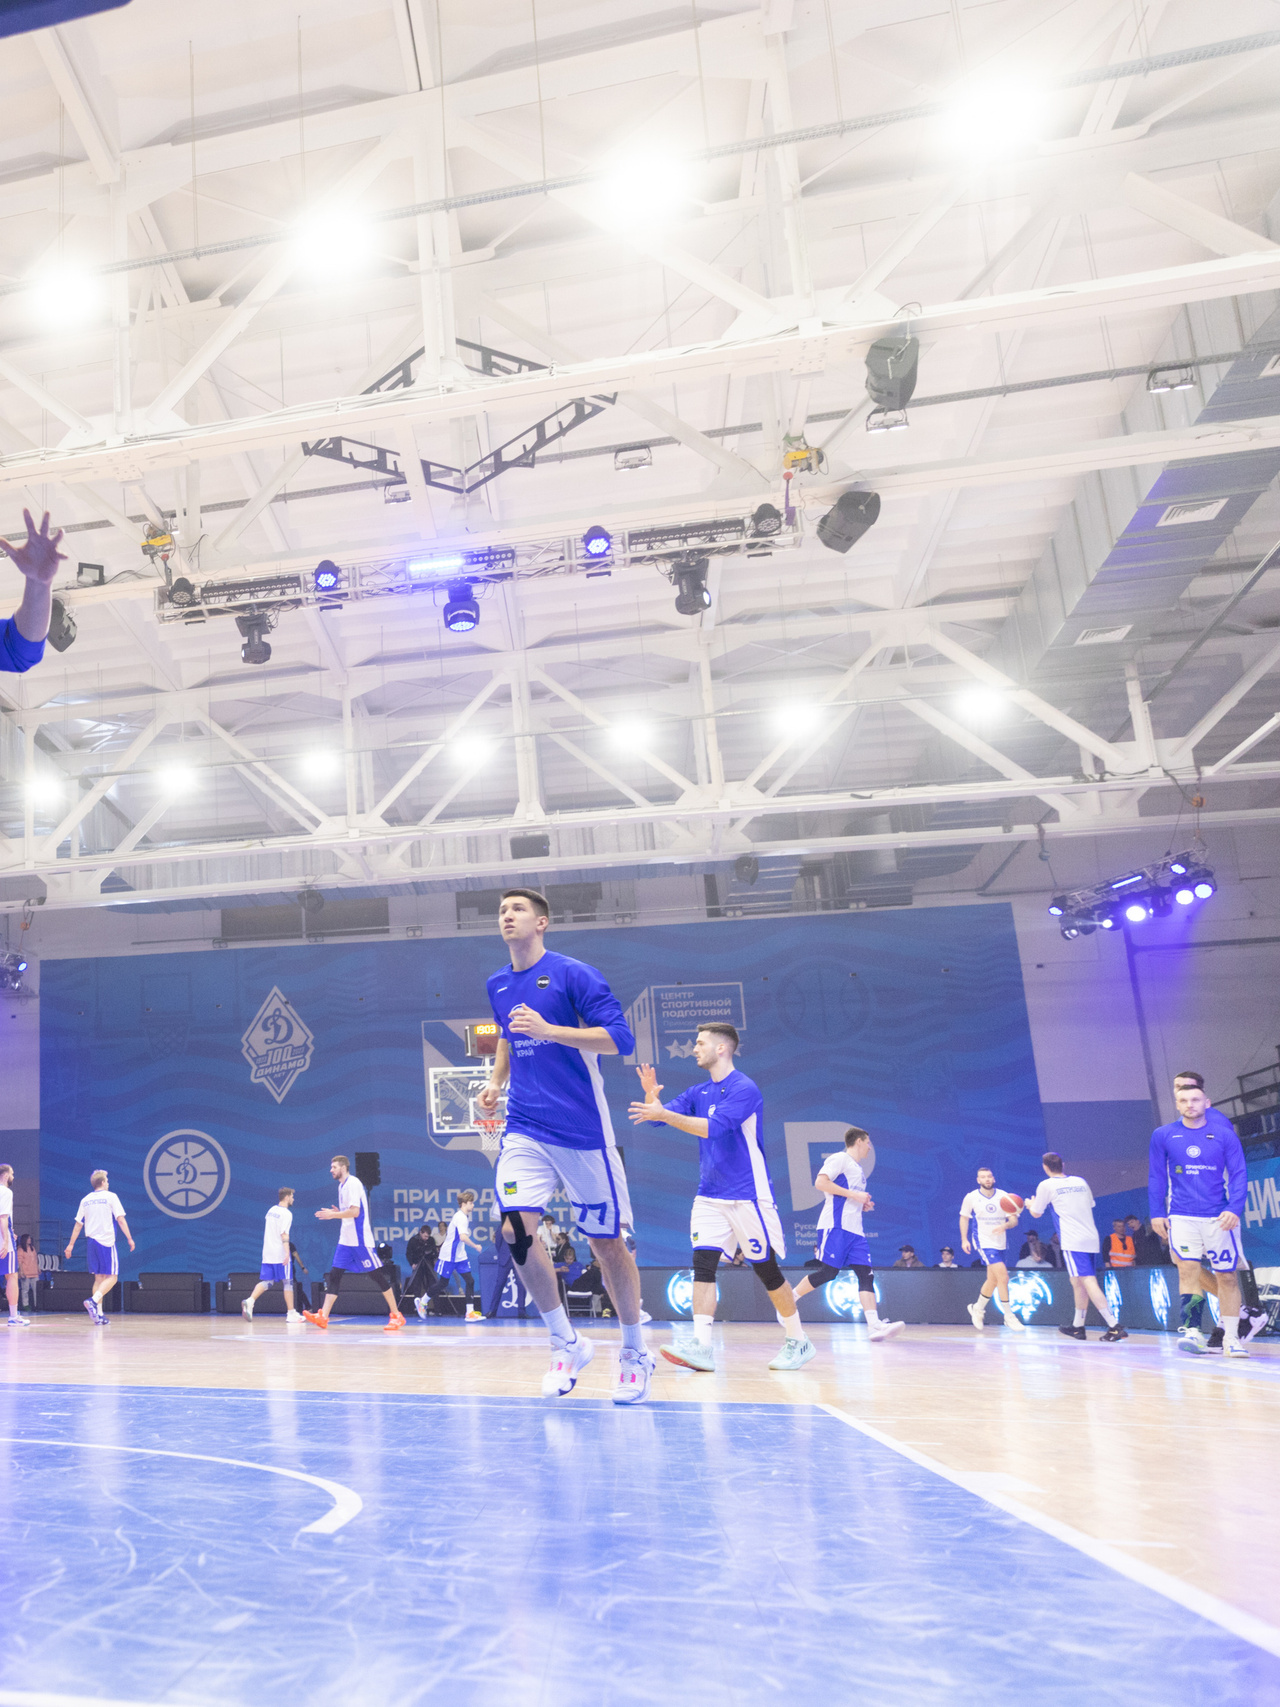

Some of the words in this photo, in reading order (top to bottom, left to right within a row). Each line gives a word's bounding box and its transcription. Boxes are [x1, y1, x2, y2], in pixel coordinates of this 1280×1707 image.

[661, 992, 694, 1000] ЦЕНТР
[661, 998, 732, 1009] СПОРТИВНОЙ
[662, 1008, 731, 1018] ПОДГОТОВКИ
[514, 1039, 556, 1048] ПРИМОРСК
[266, 1046, 292, 1066] 100
[516, 1048, 535, 1058] КРАЙ
[256, 1058, 305, 1078] ДИНАМО
[394, 1189, 440, 1204] ПРИ
[572, 1200, 607, 1226] 77
[750, 1237, 762, 1254] 3
[1206, 1249, 1234, 1264] 24
